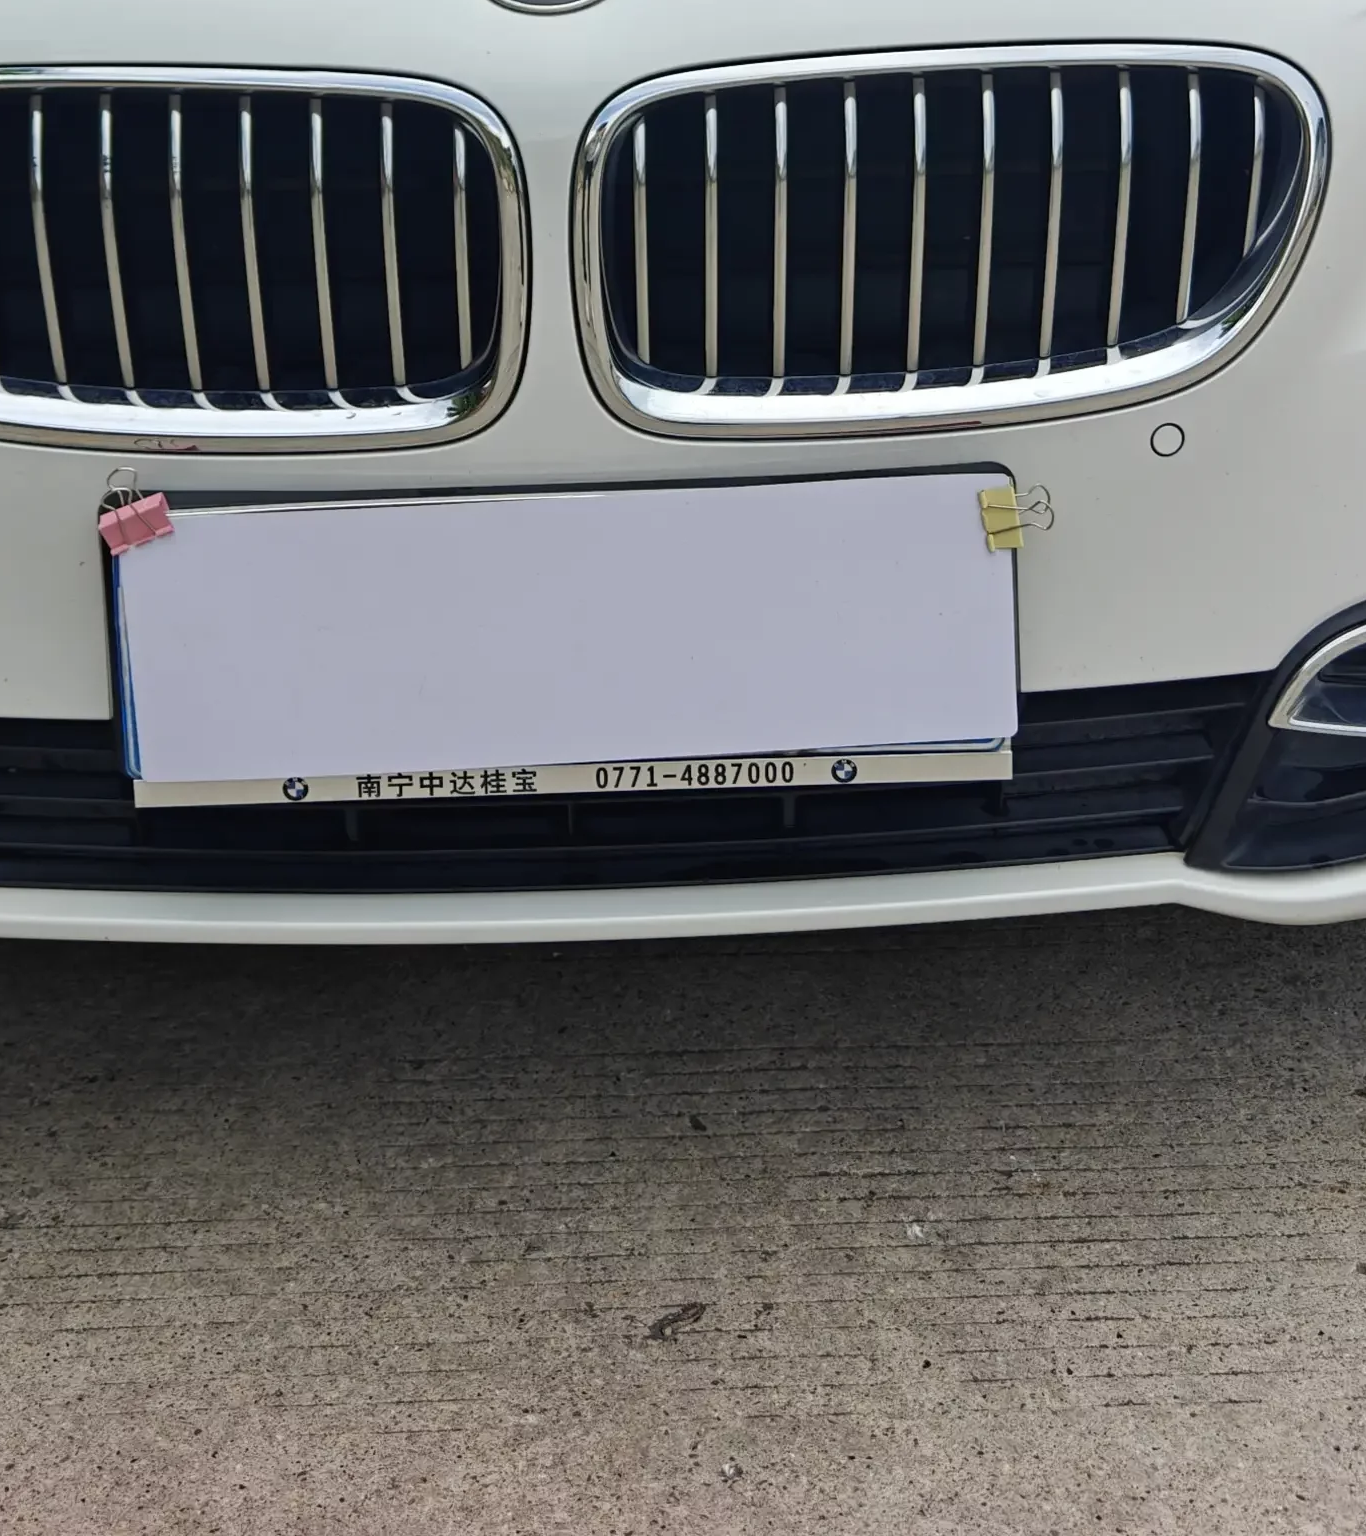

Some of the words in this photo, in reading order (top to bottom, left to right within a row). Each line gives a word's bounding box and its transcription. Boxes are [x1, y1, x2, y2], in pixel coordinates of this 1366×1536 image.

[356, 768, 538, 798] 南宁中达桂宝
[595, 761, 795, 789] 0771-4887000
